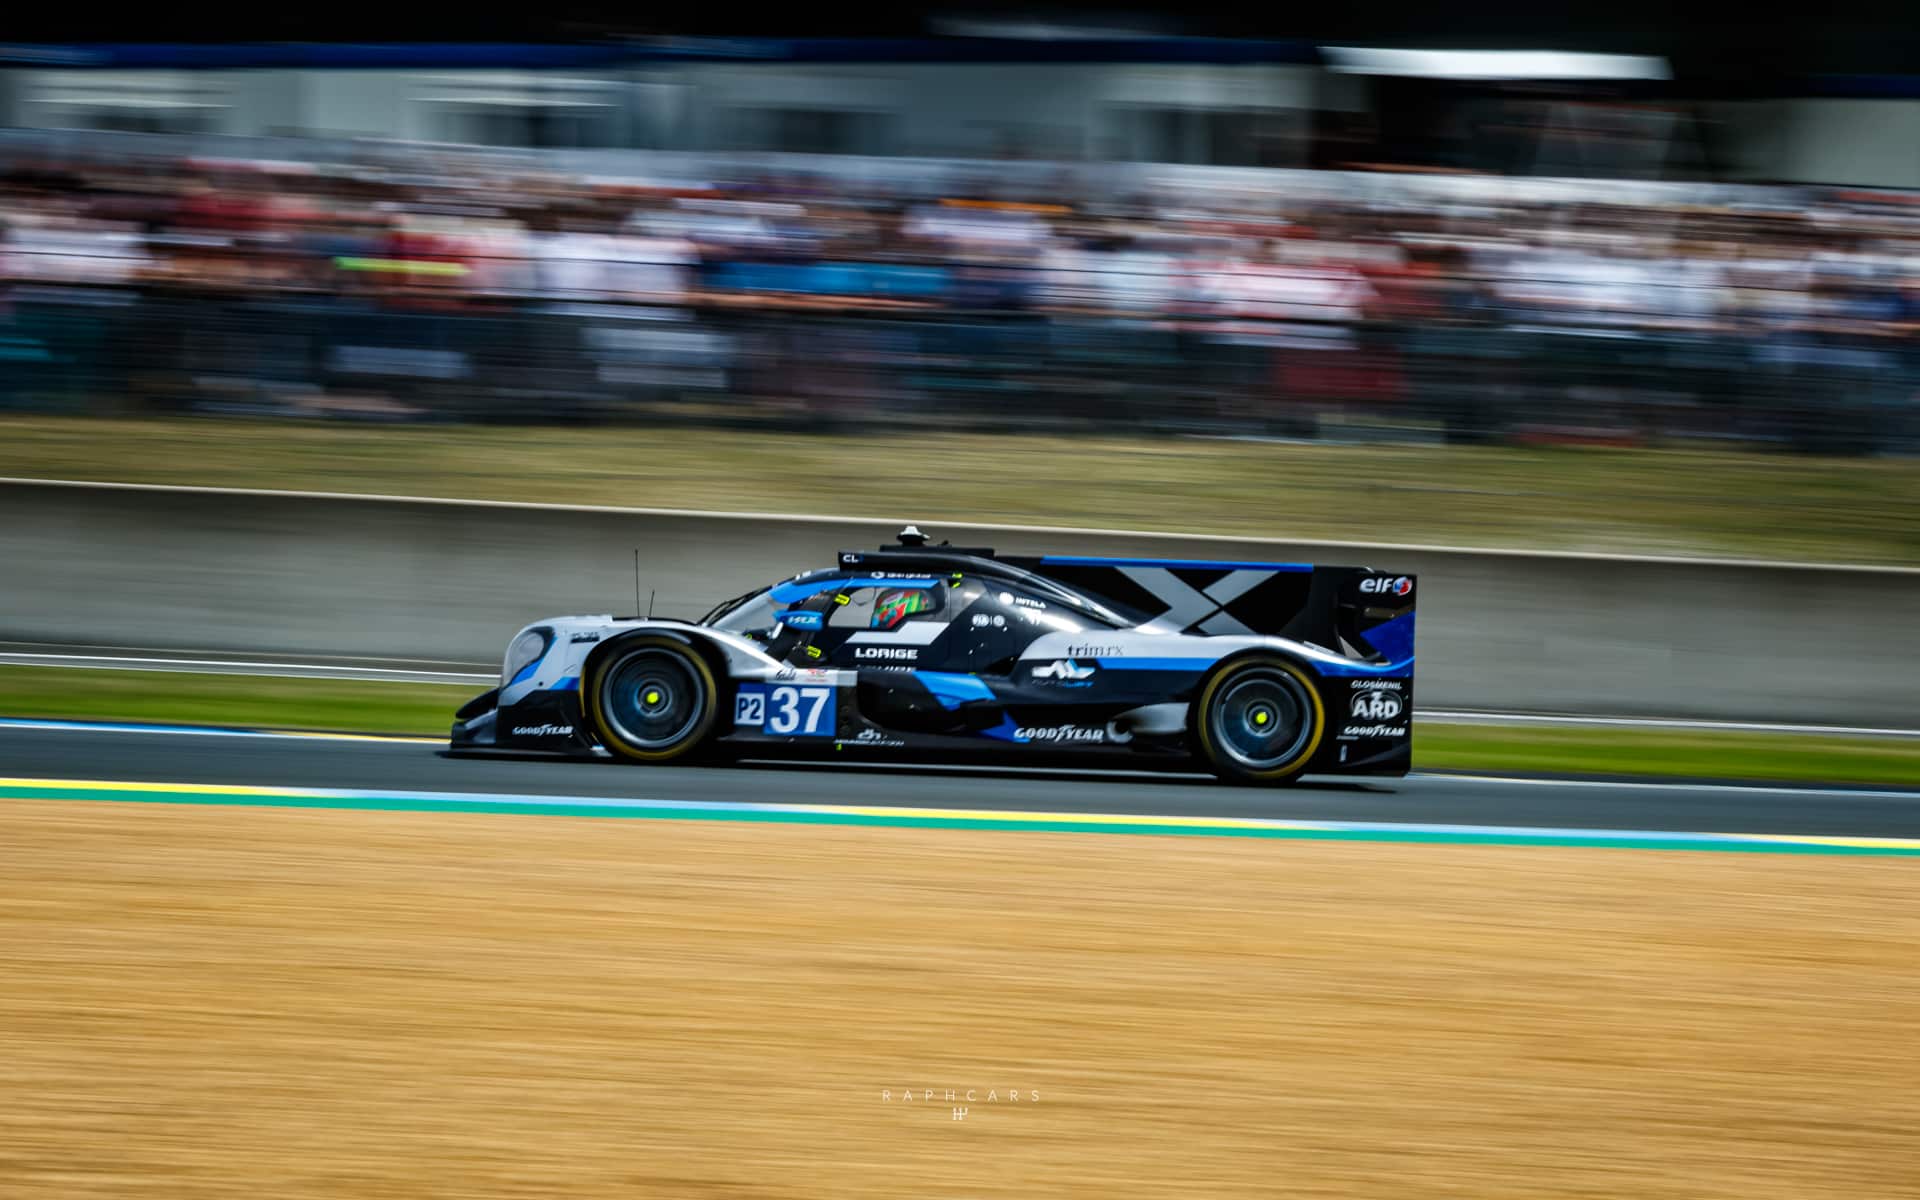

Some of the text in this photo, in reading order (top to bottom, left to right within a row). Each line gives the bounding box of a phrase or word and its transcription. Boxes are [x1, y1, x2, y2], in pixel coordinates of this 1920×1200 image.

[1359, 578, 1394, 593] elf
[855, 647, 918, 660] LORIGE
[737, 697, 762, 720] P2
[770, 686, 830, 733] 37
[1352, 699, 1399, 719] ARD
[512, 724, 574, 737] GOODYEAR
[1013, 724, 1104, 742] GOODYEAR
[1344, 724, 1405, 737] GOODYEAR
